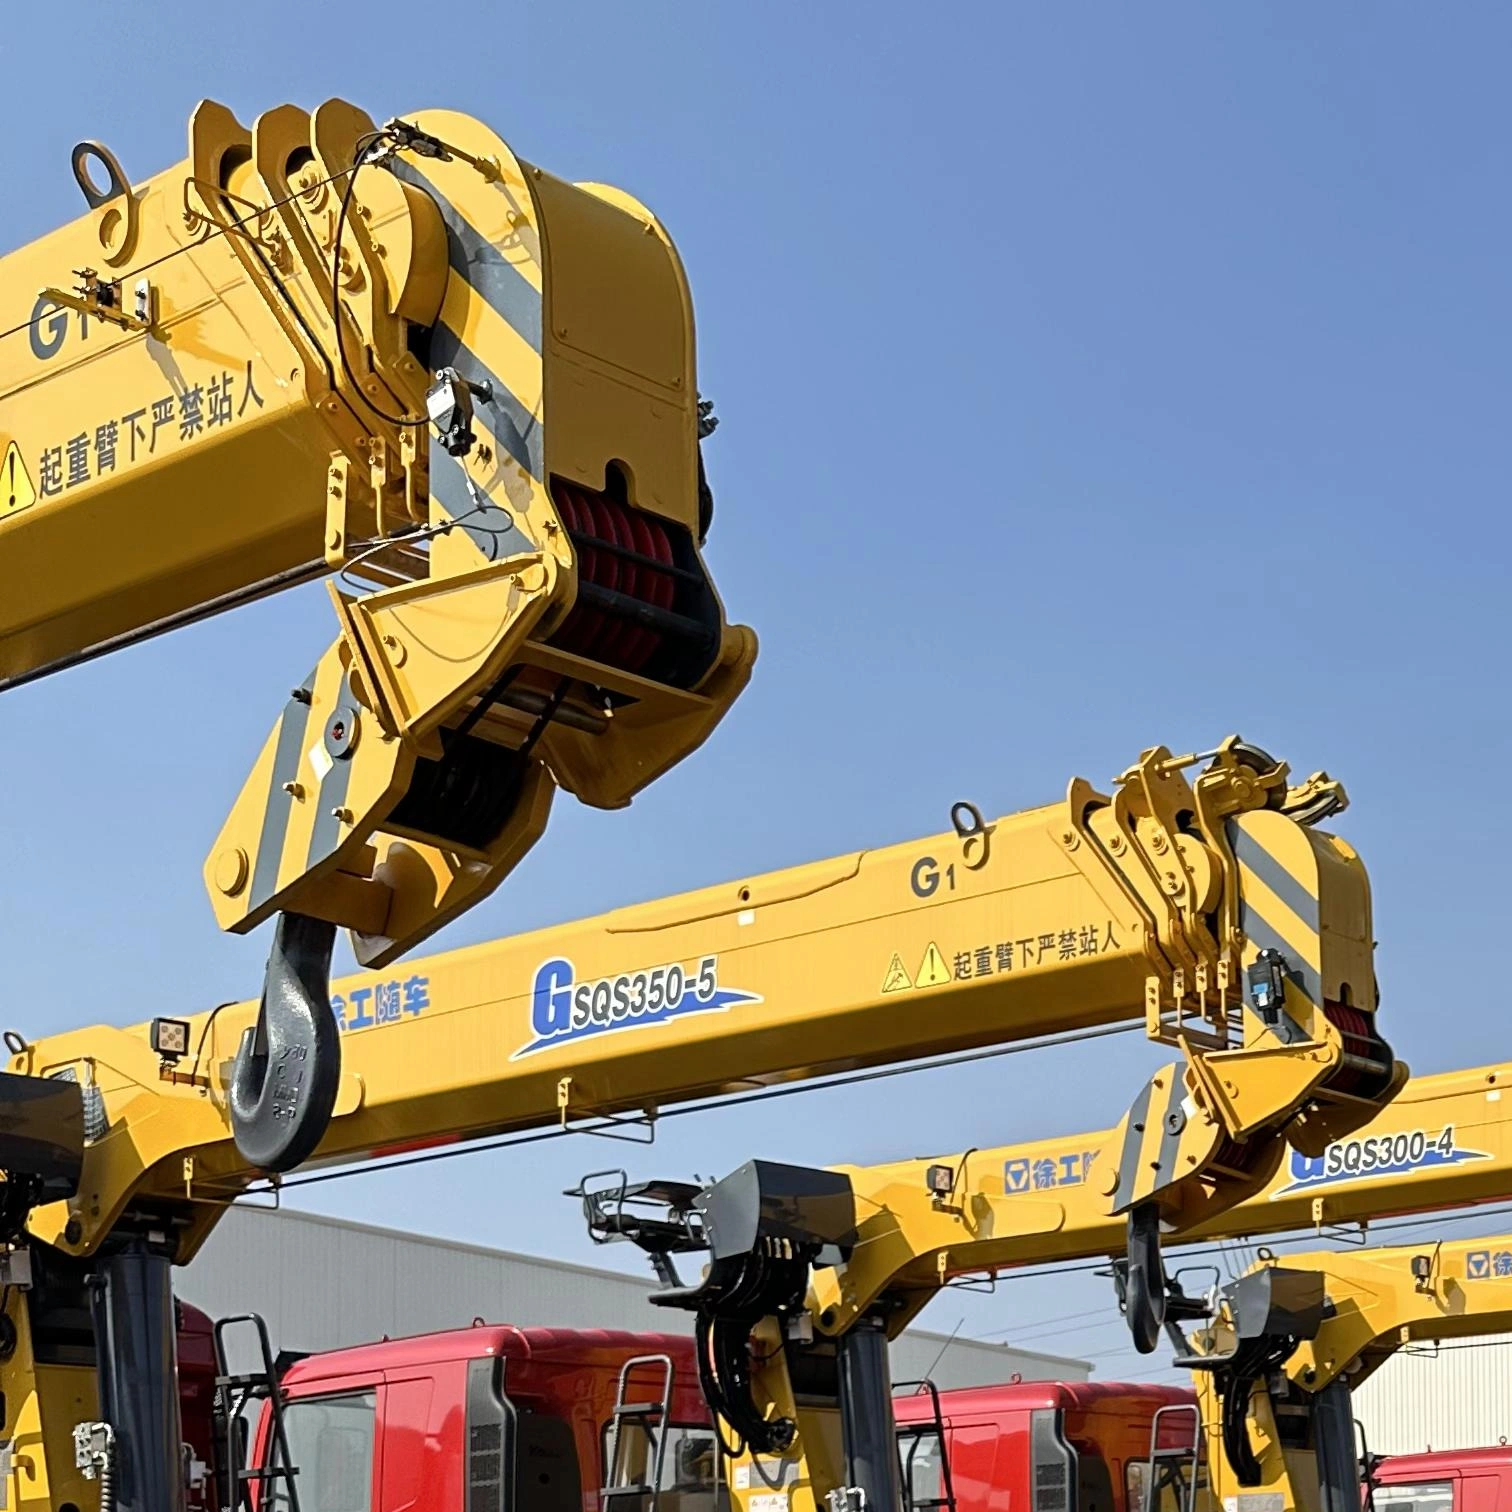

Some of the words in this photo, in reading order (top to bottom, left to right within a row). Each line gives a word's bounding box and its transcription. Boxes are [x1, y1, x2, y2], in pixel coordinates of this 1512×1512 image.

[39, 359, 265, 500] 起重臂下严禁站人
[910, 856, 956, 898] G1
[953, 920, 1121, 982] 起重臂下严禁站人
[532, 958, 717, 1037] GSQS350-5
